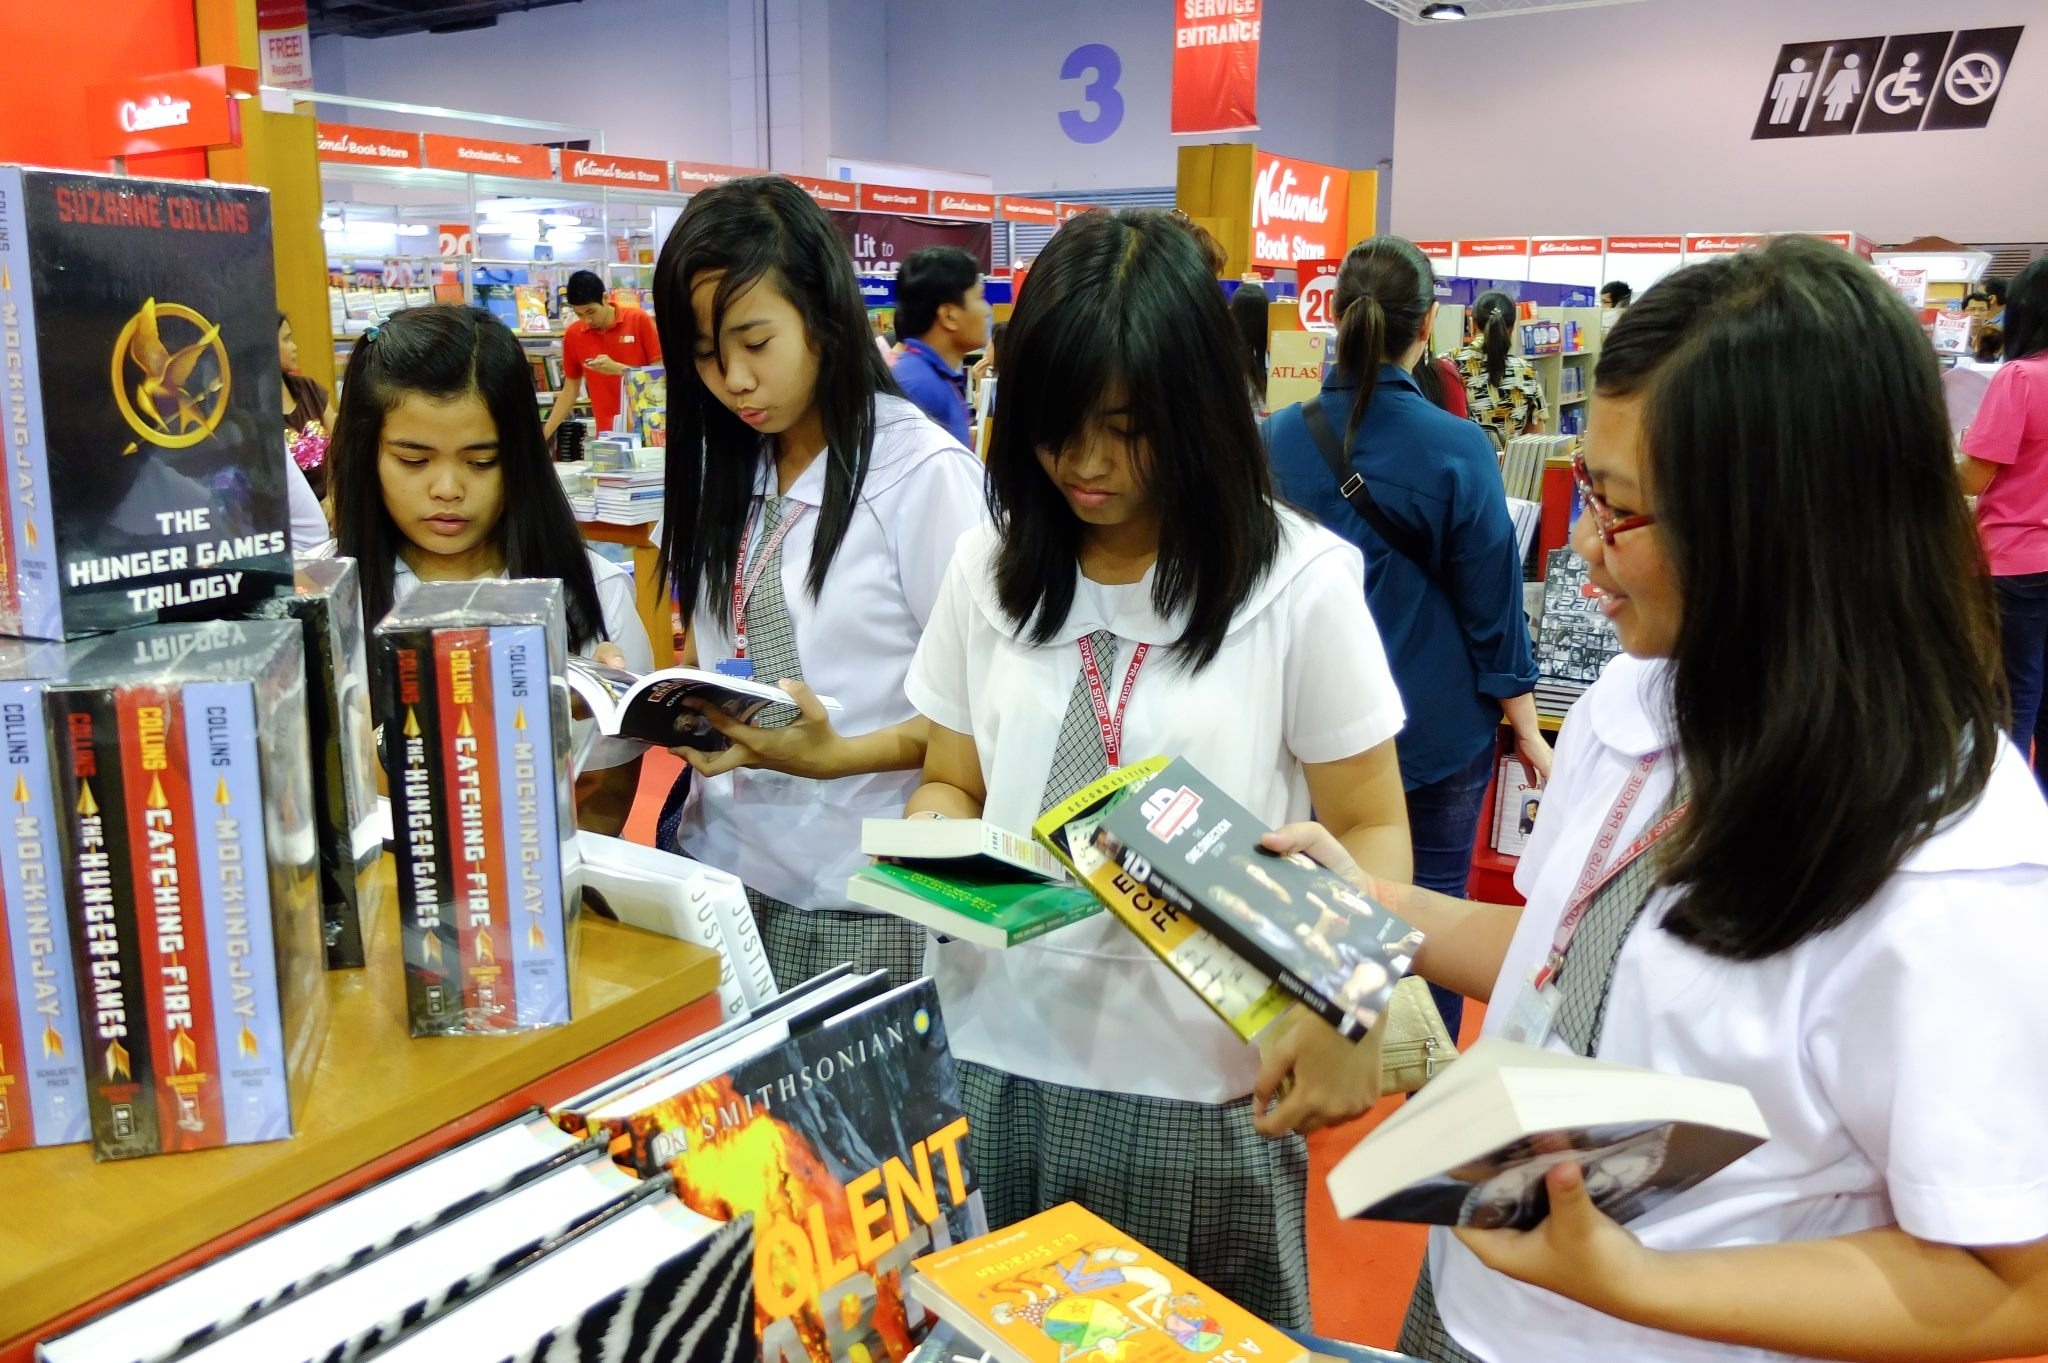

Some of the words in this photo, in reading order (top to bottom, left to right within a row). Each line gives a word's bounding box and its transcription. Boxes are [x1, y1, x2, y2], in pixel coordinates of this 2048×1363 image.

[1177, 20, 1260, 48] ENTRANCE
[1185, 0, 1255, 19] SERVICE
[1058, 43, 1125, 144] 3
[349, 142, 377, 155] Book
[378, 145, 409, 159] Store
[573, 158, 616, 178] National
[614, 167, 636, 180] Book
[637, 171, 661, 183] Store
[56, 187, 161, 229] SUZANNE
[167, 196, 249, 235] COLLINS
[1252, 160, 1331, 229] National
[854, 233, 877, 259] Lit
[881, 241, 895, 257] to
[1255, 235, 1289, 261] Book
[1292, 236, 1326, 261] Store
[1271, 366, 1318, 380] ATLAS
[2, 303, 36, 509] MOCKINGJAY
[156, 507, 212, 537] THE
[69, 551, 189, 588] HUNGER
[196, 530, 286, 566] GAMES
[127, 571, 243, 613] TRILOGY
[396, 648, 421, 705] COLLINS
[449, 648, 474, 706] COLLINS
[508, 644, 528, 698] COLLINS
[1088, 673, 1100, 686] OF
[1135, 646, 1147, 660] OF
[1093, 688, 1110, 720] JESUS
[1120, 662, 1141, 706] PRAGUE
[3, 704, 30, 765] COLLINS
[67, 711, 98, 778] COLLINS
[136, 704, 168, 771] COLLINS
[205, 705, 233, 768] COLLINS
[404, 738, 424, 765] THE
[1102, 722, 1117, 754] CHILD
[403, 768, 436, 857] HUNGER
[454, 737, 486, 862] CATCHING
[79, 815, 101, 848] THE
[512, 742, 545, 916] MOCKINGJAY
[79, 852, 117, 957] HUNGER
[144, 808, 186, 953] CATCHING
[412, 860, 441, 930] GAMES
[465, 872, 491, 928] FIRE
[14, 815, 63, 1018] MOCKINGJAY
[213, 817, 257, 1018] MOCKINGJAY
[691, 890, 733, 995] JUSTIN
[731, 904, 773, 1000] JUSTIN
[91, 959, 128, 1039] GAMES
[161, 965, 193, 1030] FIRE
[700, 1023, 906, 1143] SMITHSONIAN
[1237, 1335, 1264, 1355] A
